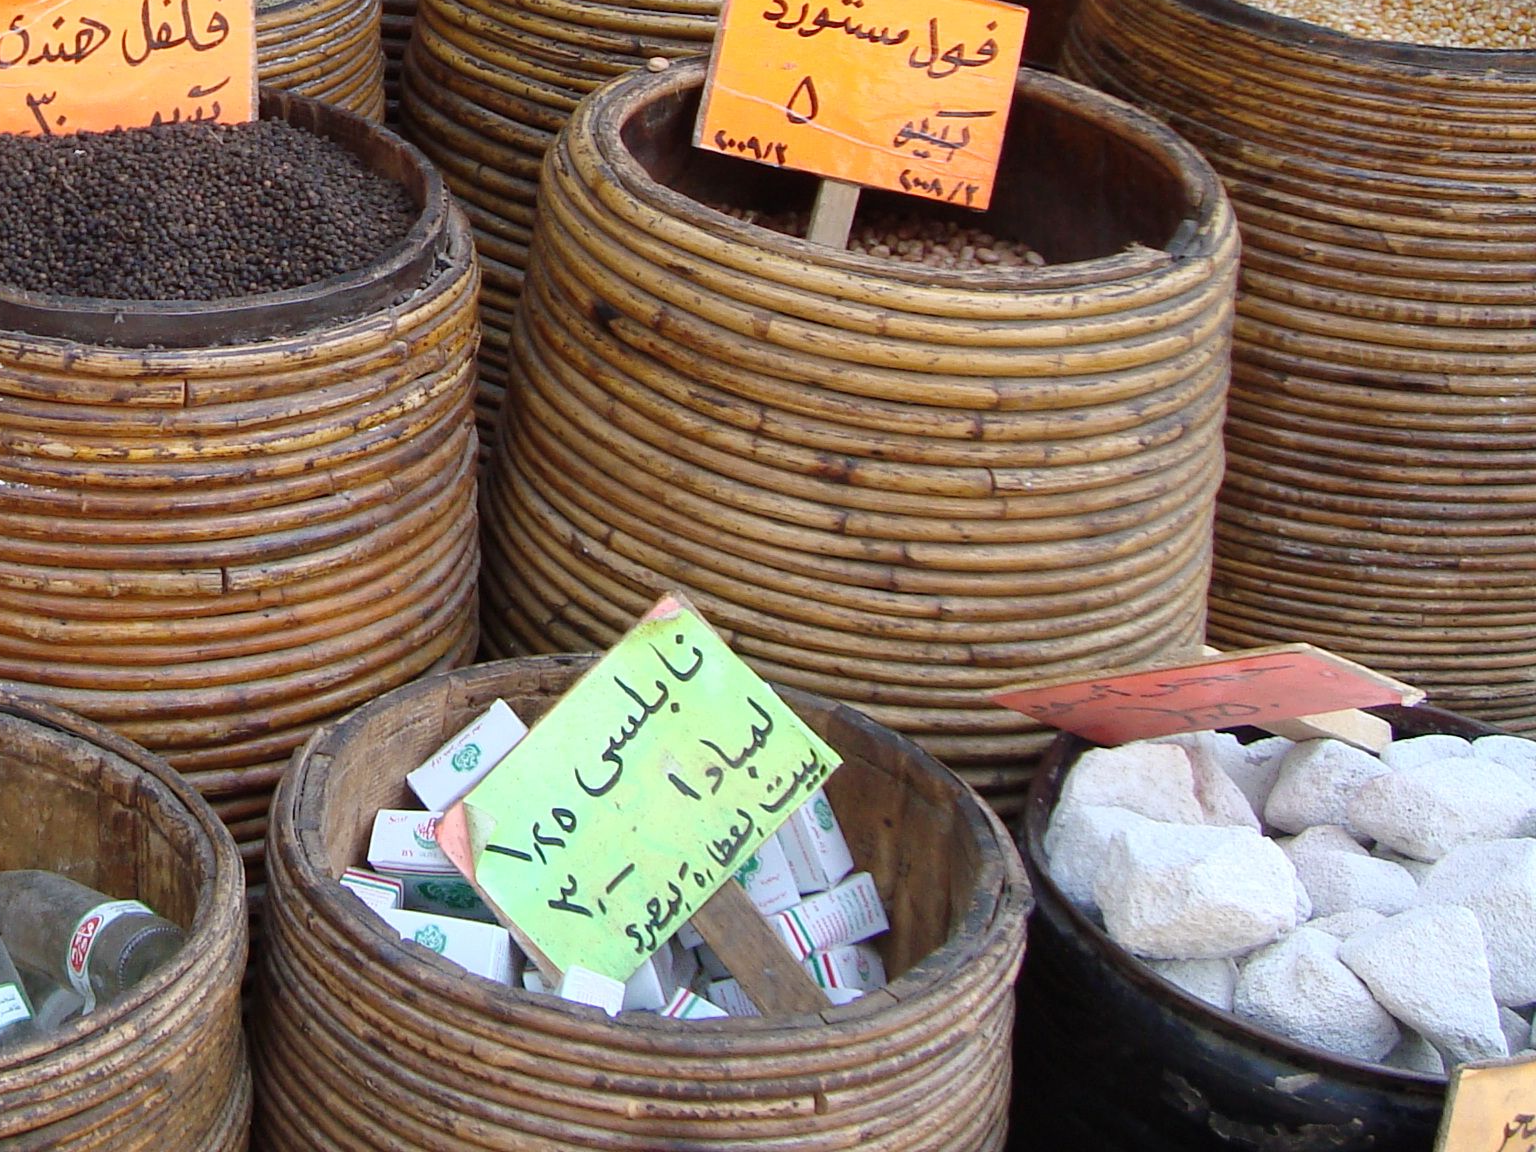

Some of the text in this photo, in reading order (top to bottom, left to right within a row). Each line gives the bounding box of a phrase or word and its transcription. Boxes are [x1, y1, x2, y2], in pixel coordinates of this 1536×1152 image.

[908, 17, 999, 78] فول
[786, 76, 819, 124] ٥
[760, 748, 827, 816] بيت
